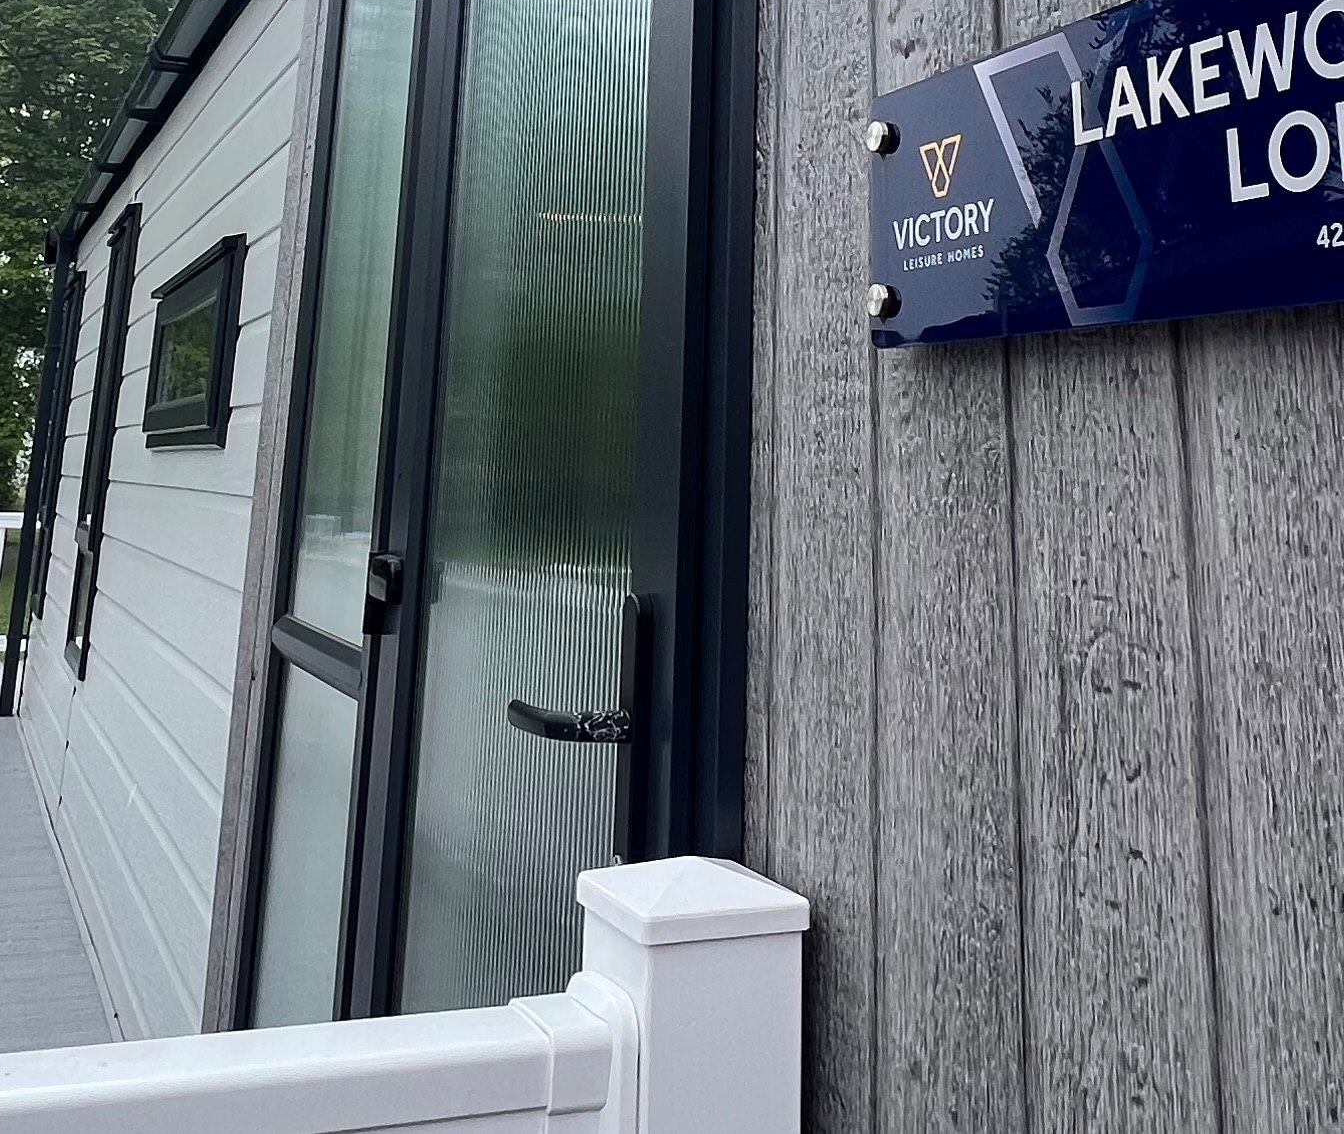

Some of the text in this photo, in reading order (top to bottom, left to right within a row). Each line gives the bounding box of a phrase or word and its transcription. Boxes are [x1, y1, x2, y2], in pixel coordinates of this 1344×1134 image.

[892, 197, 995, 251] VICTORY
[902, 244, 985, 272] LEISURE HOMES
